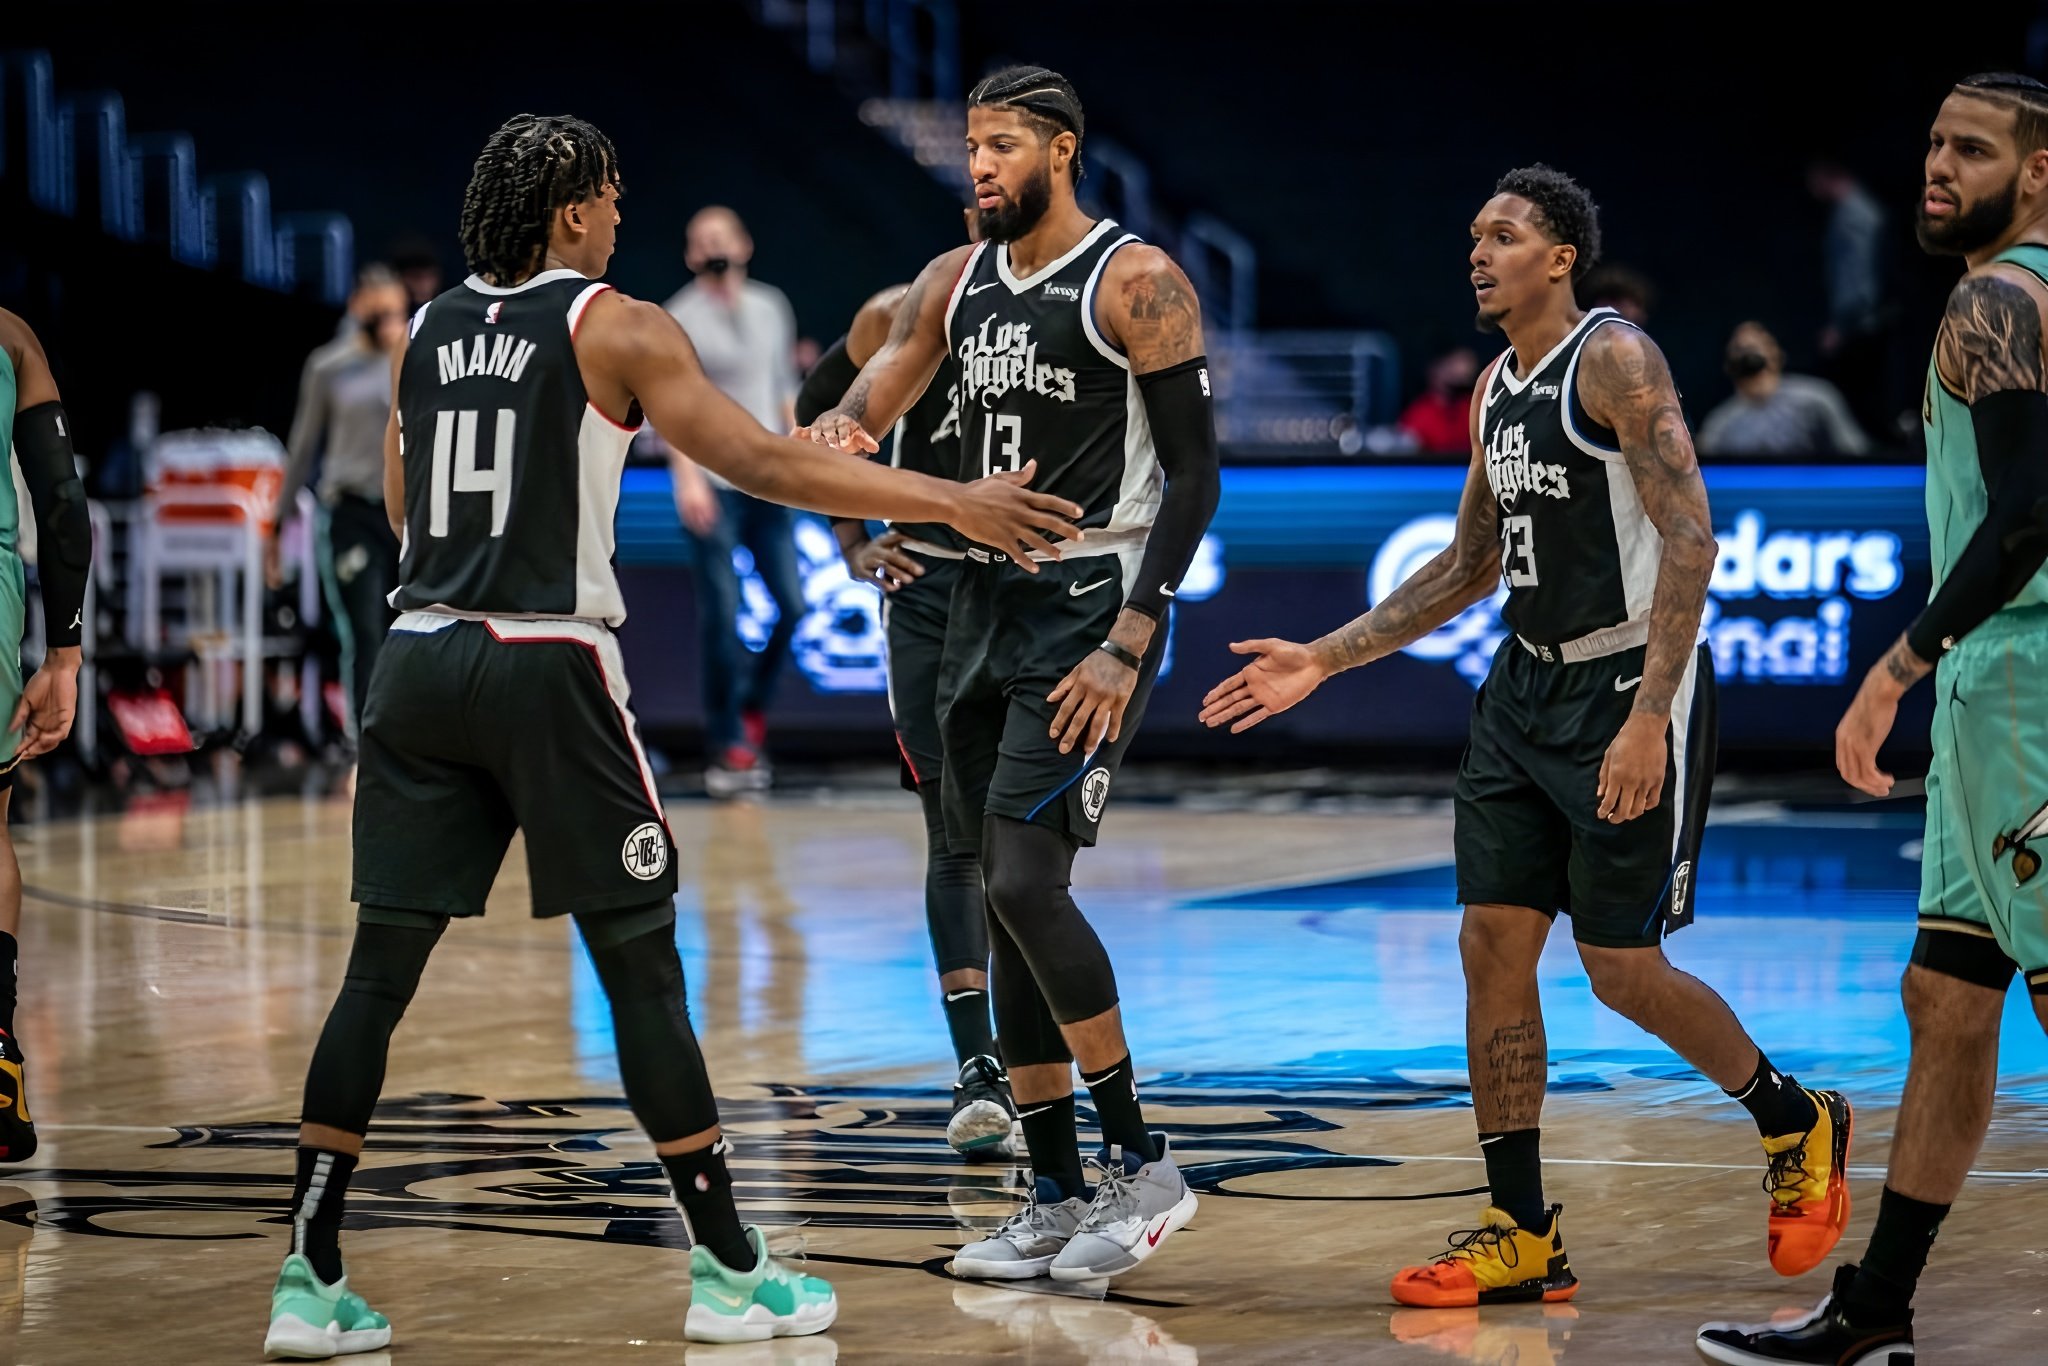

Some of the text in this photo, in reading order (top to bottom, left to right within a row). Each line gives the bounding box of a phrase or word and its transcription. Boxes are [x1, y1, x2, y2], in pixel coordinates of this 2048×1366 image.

[437, 334, 537, 385] MANN
[975, 312, 1031, 357] Los
[959, 335, 1077, 411] Angeles
[429, 409, 516, 537] 14
[982, 412, 1022, 478] 13
[1707, 510, 1903, 598] dars
